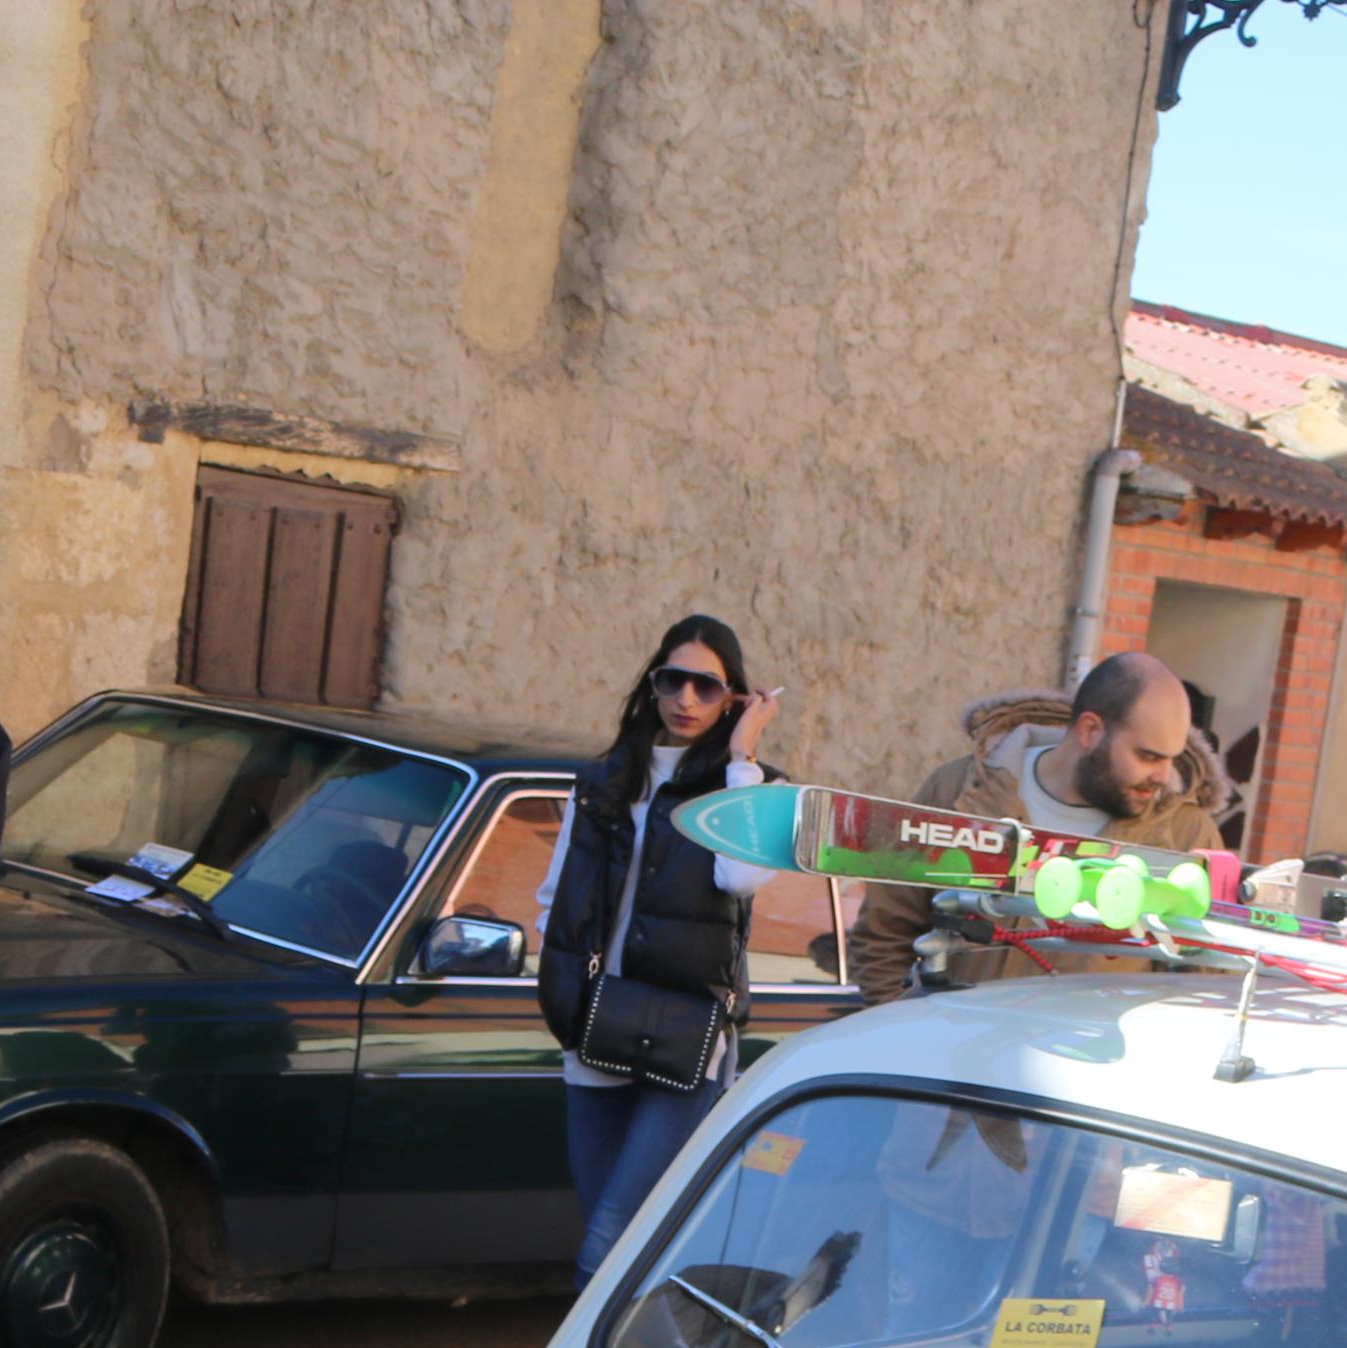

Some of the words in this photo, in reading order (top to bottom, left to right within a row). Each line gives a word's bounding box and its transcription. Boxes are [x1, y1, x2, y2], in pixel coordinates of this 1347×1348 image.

[900, 818, 1004, 856] HEAD
[1004, 1321, 1021, 1333] LA
[1026, 1322, 1091, 1336] CORBATA
